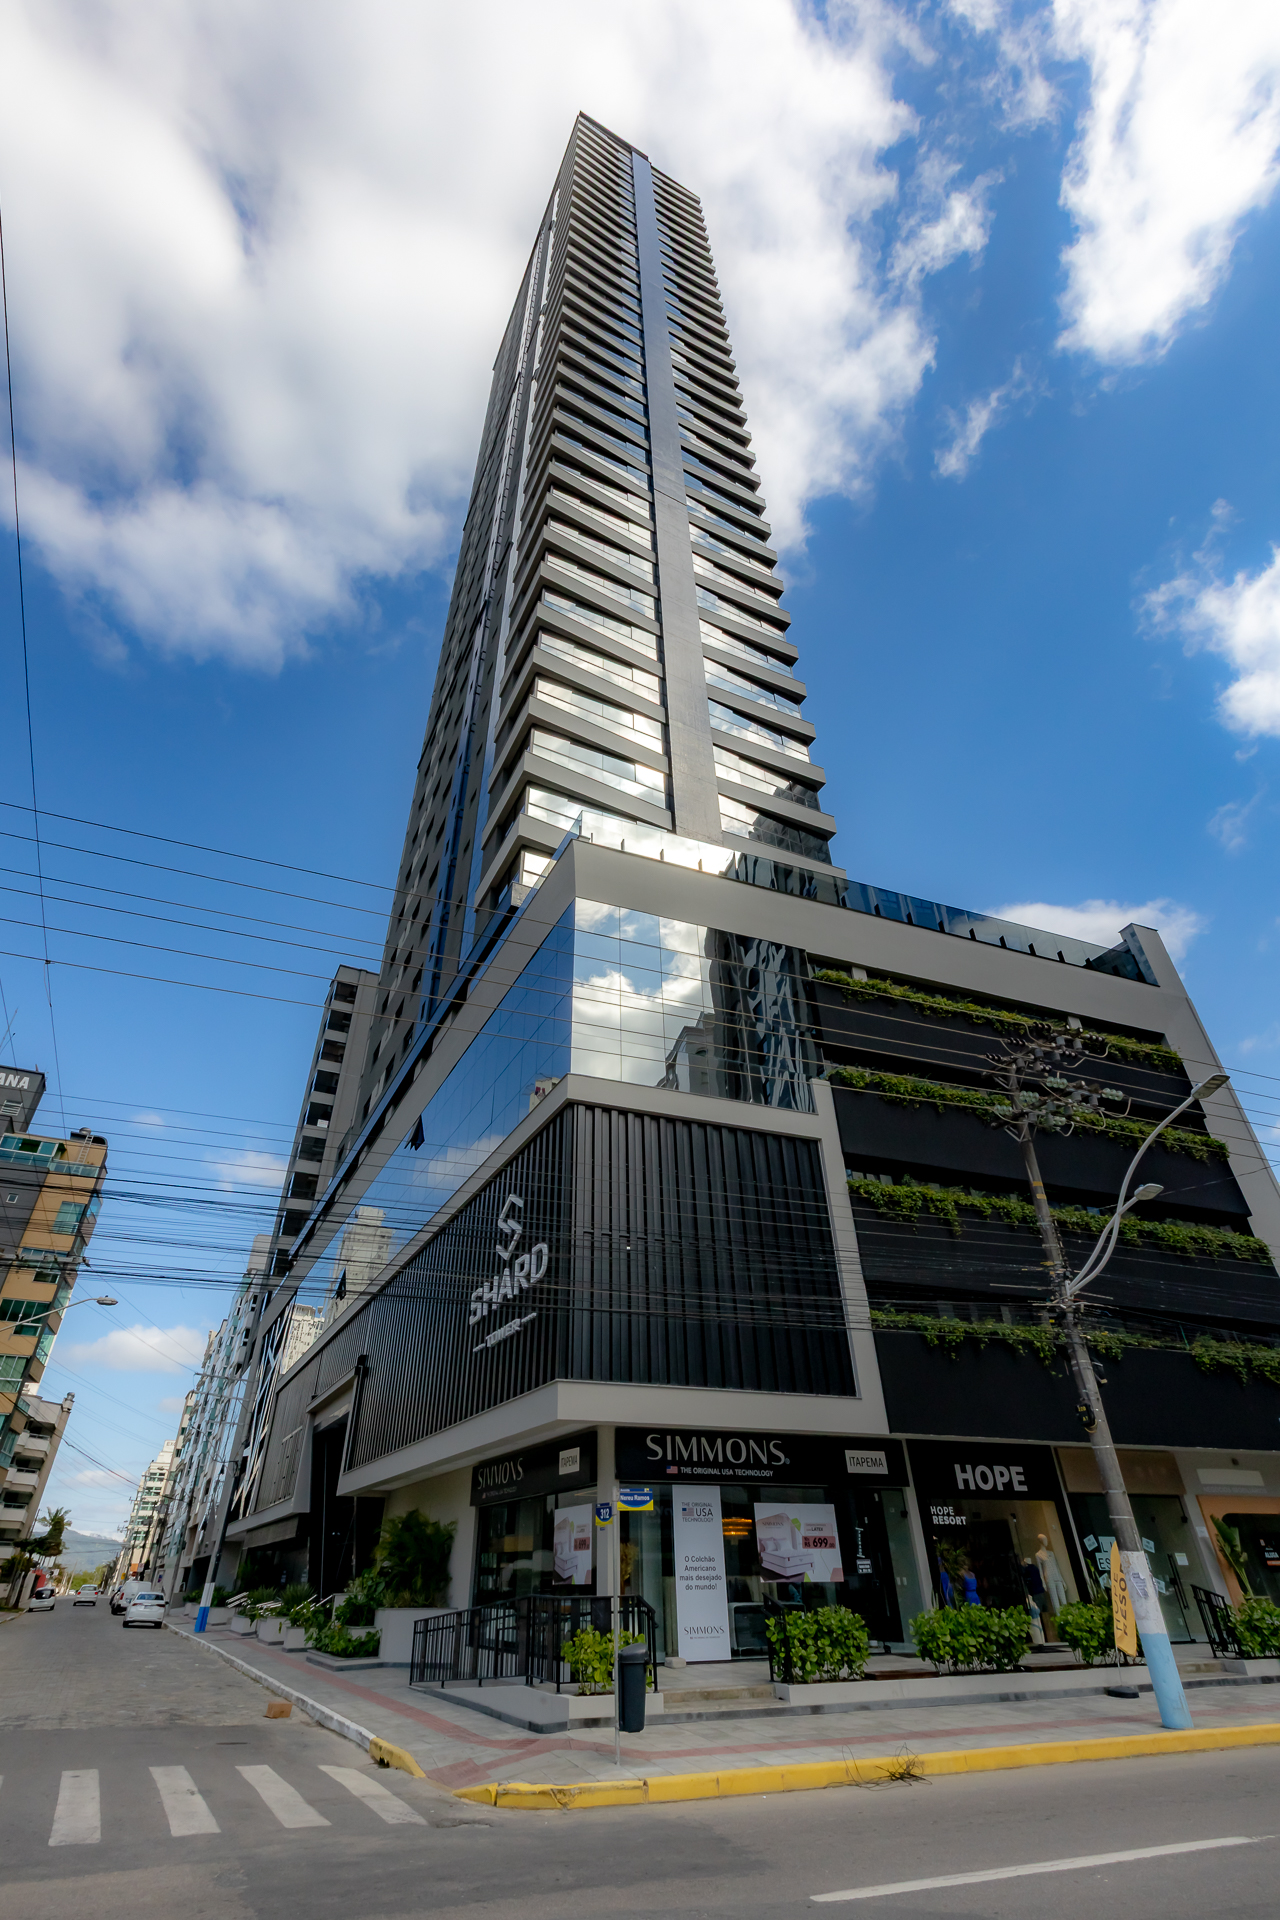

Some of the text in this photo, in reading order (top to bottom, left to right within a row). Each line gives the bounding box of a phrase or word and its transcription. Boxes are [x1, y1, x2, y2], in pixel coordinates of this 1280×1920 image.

[468, 1242, 549, 1326] SHARD
[485, 1318, 521, 1348] TOWER
[848, 1456, 884, 1468] ITAPEMA
[477, 1457, 525, 1490] SIMMONS
[680, 1466, 774, 1477] THE ORIGINAL USA TECHNOLOGY
[953, 1463, 1029, 1491] HOPE
[600, 1508, 610, 1519] 312
[695, 1507, 714, 1517] USA
[930, 1505, 954, 1515] HOPE
[932, 1515, 967, 1525] RESORT
[812, 1537, 829, 1548] 699
[695, 1574, 722, 1582] desejado
[683, 1625, 725, 1636] SIMMONS
